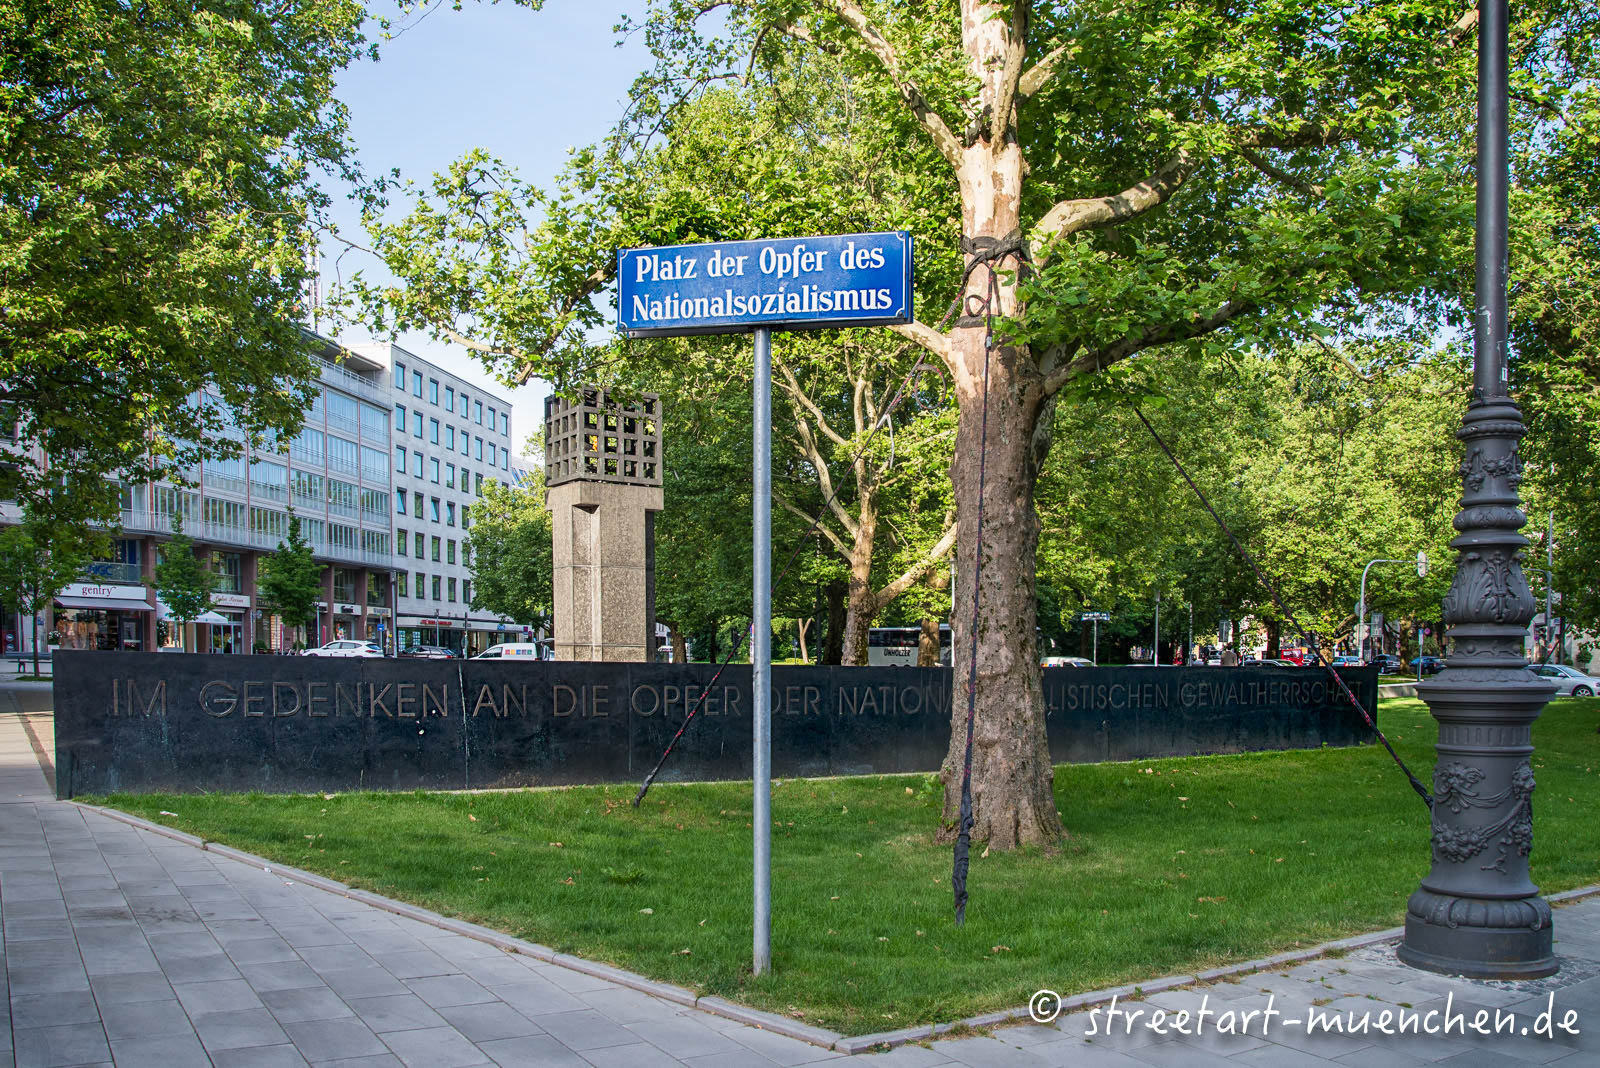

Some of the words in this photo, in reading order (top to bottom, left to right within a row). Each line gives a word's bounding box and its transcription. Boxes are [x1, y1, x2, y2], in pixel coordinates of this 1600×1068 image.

[635, 254, 697, 283] Platz
[707, 249, 749, 278] der
[759, 244, 828, 280] Opfer
[839, 241, 886, 271] des
[631, 284, 893, 322] Nationalsozialismus
[82, 585, 116, 598] gentry
[112, 678, 167, 717] IM
[199, 680, 448, 718] GEDENKEN
[472, 683, 528, 718] AN
[553, 684, 609, 718] DIE
[631, 684, 742, 717] OPFER
